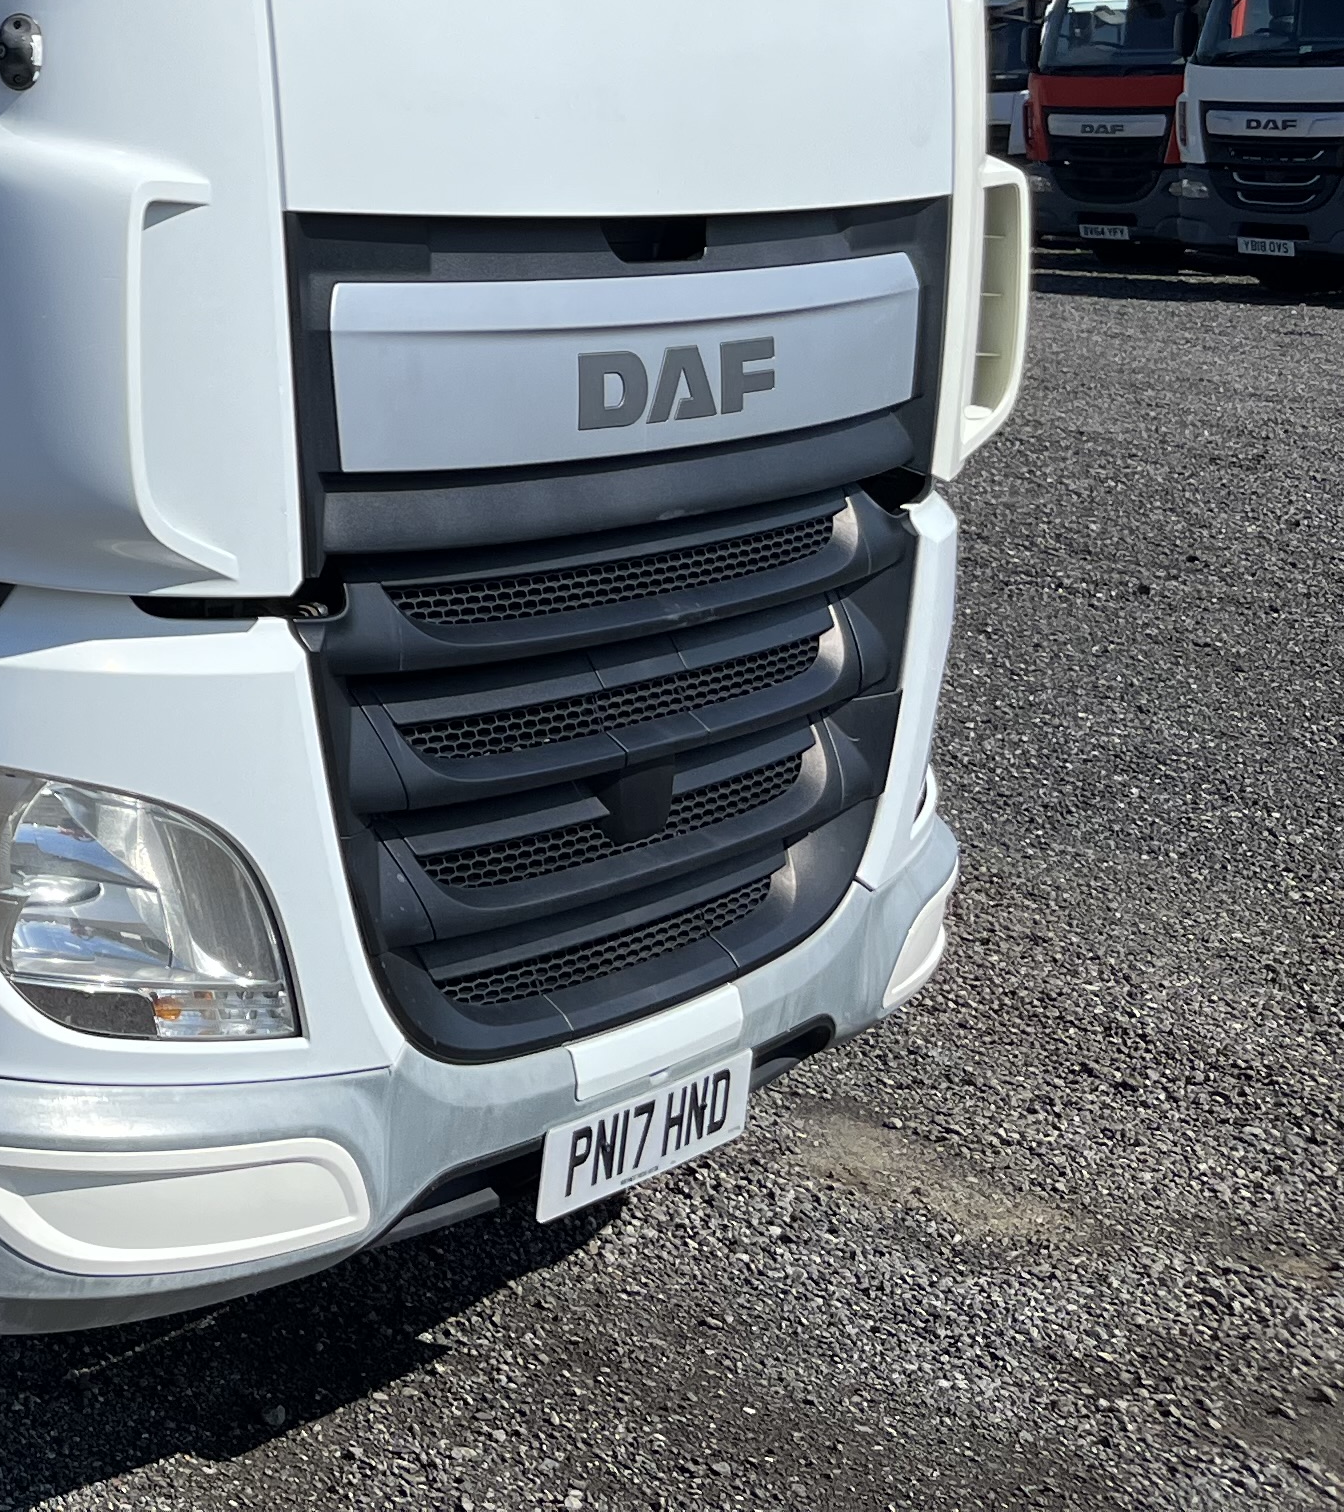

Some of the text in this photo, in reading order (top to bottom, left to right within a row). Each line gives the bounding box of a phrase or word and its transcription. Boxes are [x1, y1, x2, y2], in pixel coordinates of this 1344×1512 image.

[1080, 124, 1125, 135] DAF
[1245, 118, 1298, 131] DAF
[577, 336, 775, 431] DAF
[564, 1068, 731, 1198] PN17 HND
